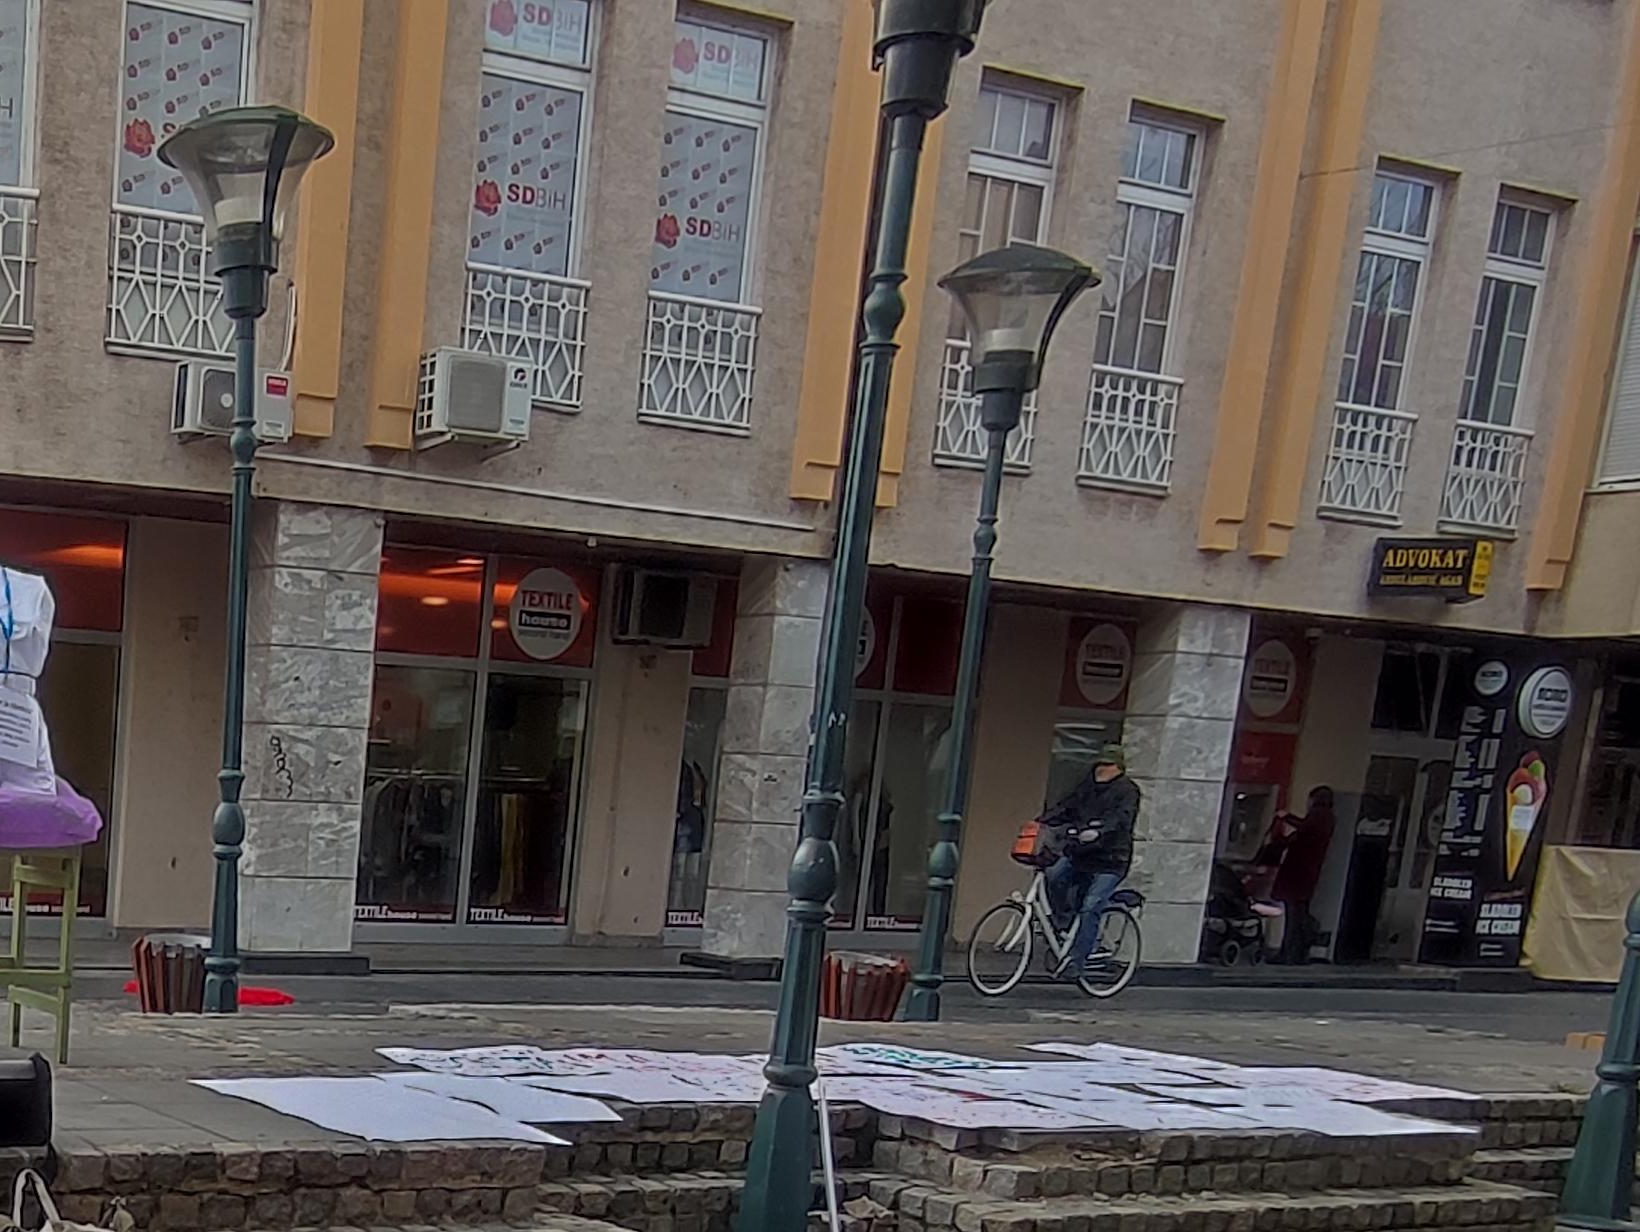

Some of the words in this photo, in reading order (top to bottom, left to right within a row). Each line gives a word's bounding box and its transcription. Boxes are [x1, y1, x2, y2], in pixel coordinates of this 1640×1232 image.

[1382, 548, 1469, 569] ADVOKAT
[521, 590, 573, 611] TEXTILE
[521, 612, 568, 628] house
